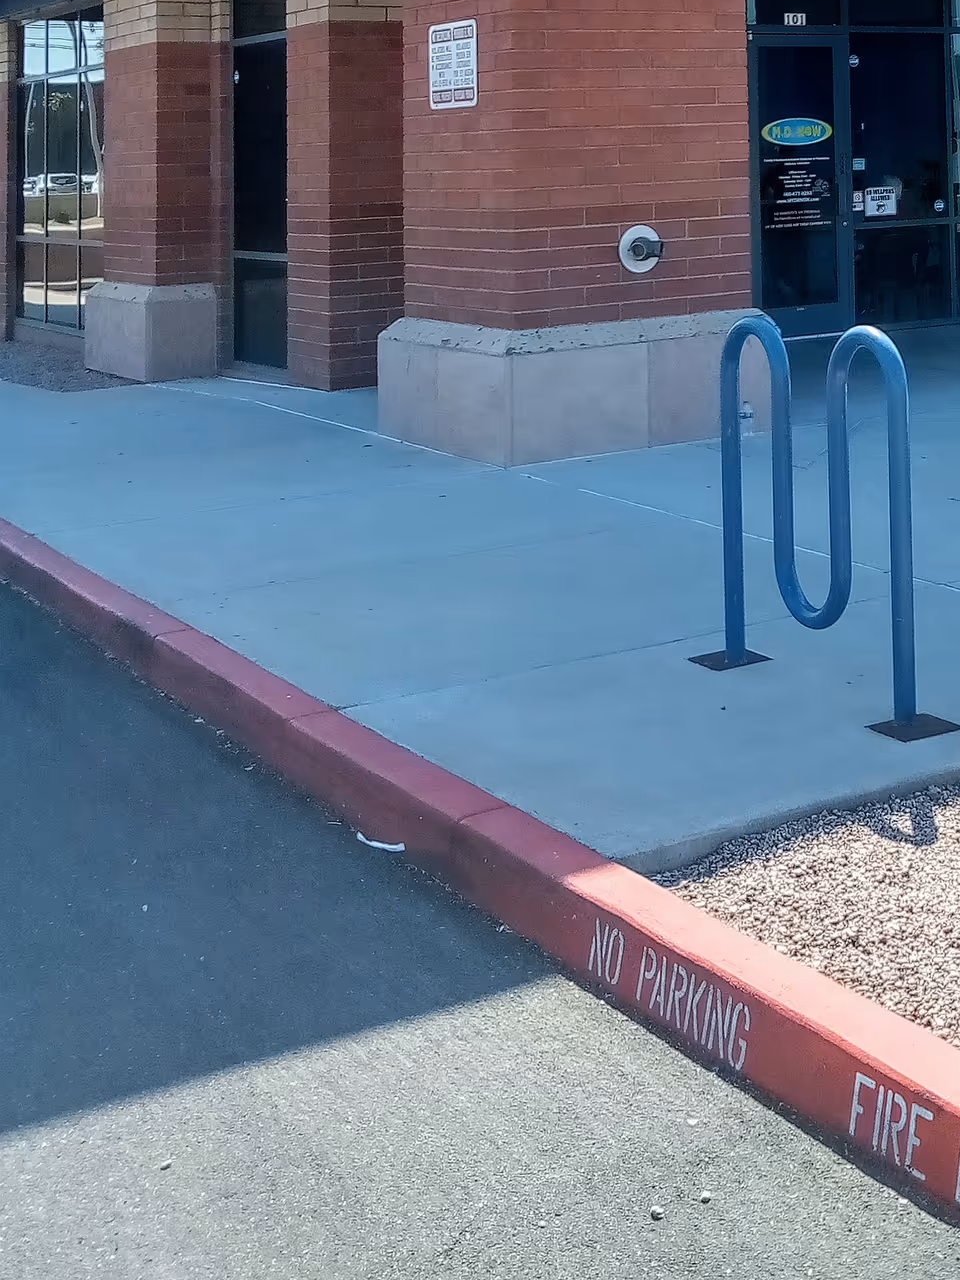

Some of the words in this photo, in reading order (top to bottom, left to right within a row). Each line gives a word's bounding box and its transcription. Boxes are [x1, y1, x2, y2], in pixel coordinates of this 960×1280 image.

[786, 14, 804, 25] 101
[588, 917, 625, 985] NO
[636, 946, 750, 1070] PARKING
[849, 1071, 934, 1181] FIRE
